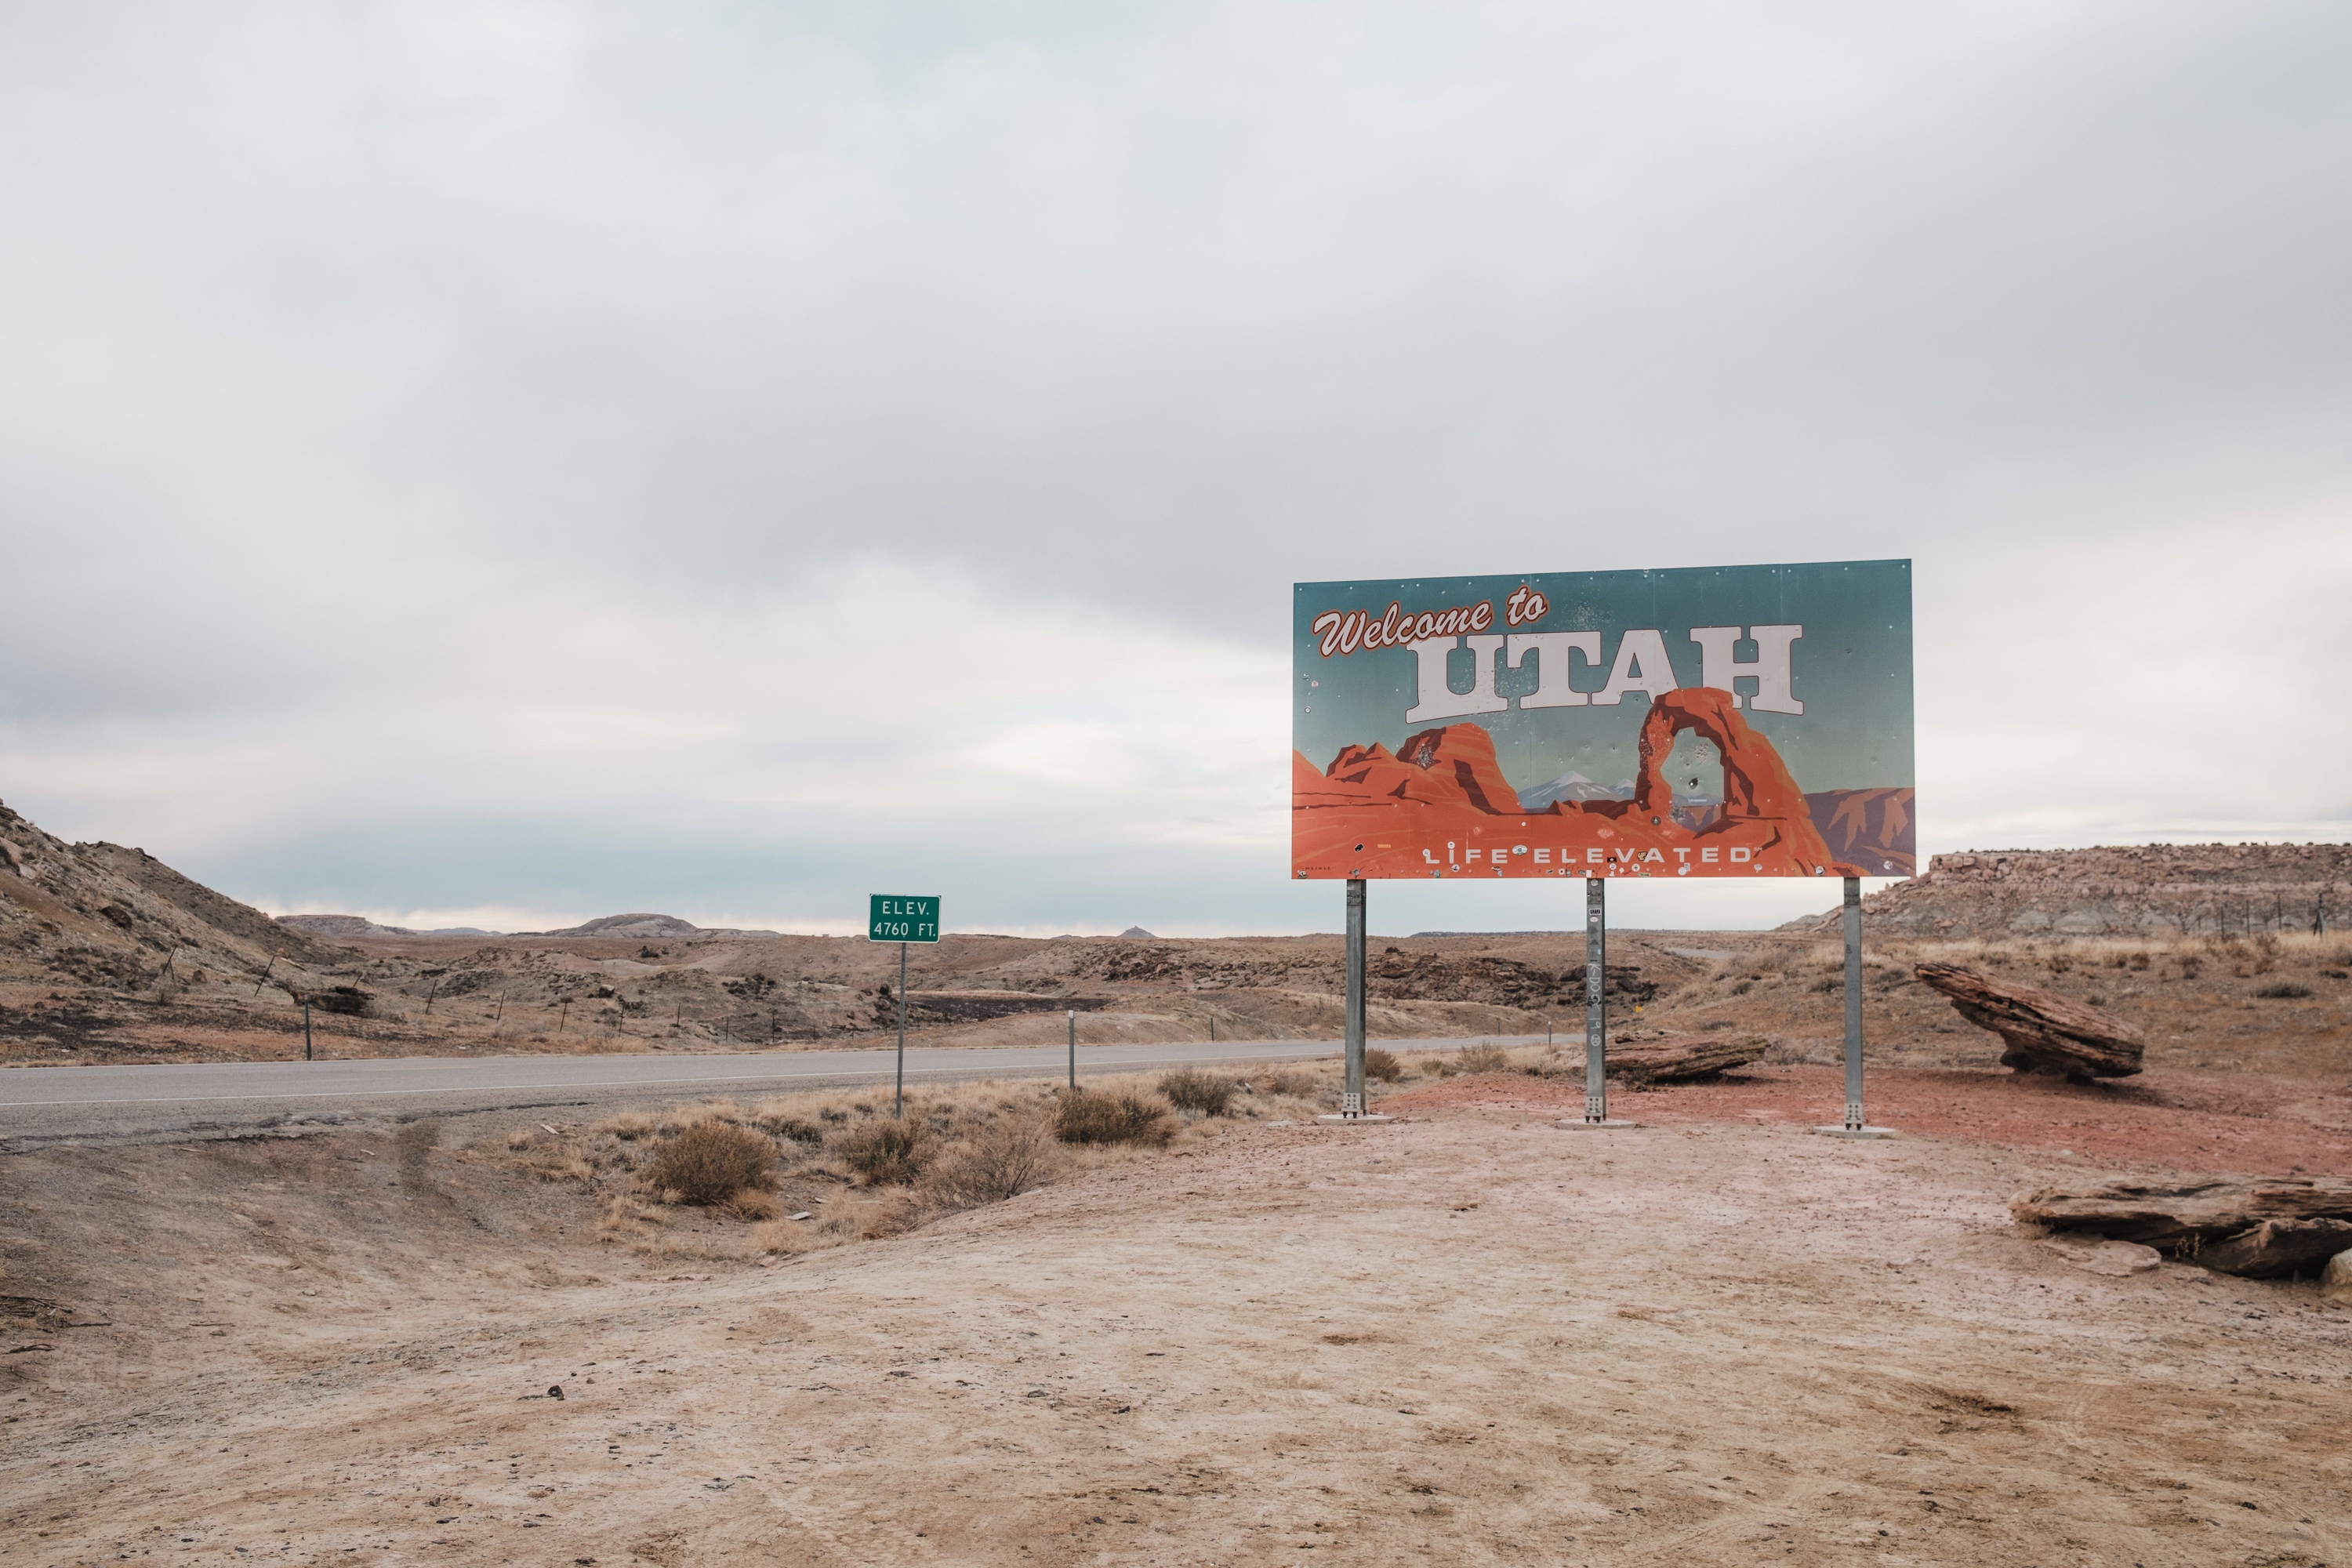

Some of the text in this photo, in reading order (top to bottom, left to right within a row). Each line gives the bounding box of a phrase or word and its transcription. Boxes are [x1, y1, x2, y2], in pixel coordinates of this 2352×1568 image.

[1312, 586, 1548, 657] Welcome to
[1406, 624, 1804, 724] UTAH
[1425, 848, 1508, 864] LIFE
[1534, 847, 1751, 863] ELEVATED
[882, 901, 930, 916] ELEV.
[873, 922, 936, 937] 4760 FT.
